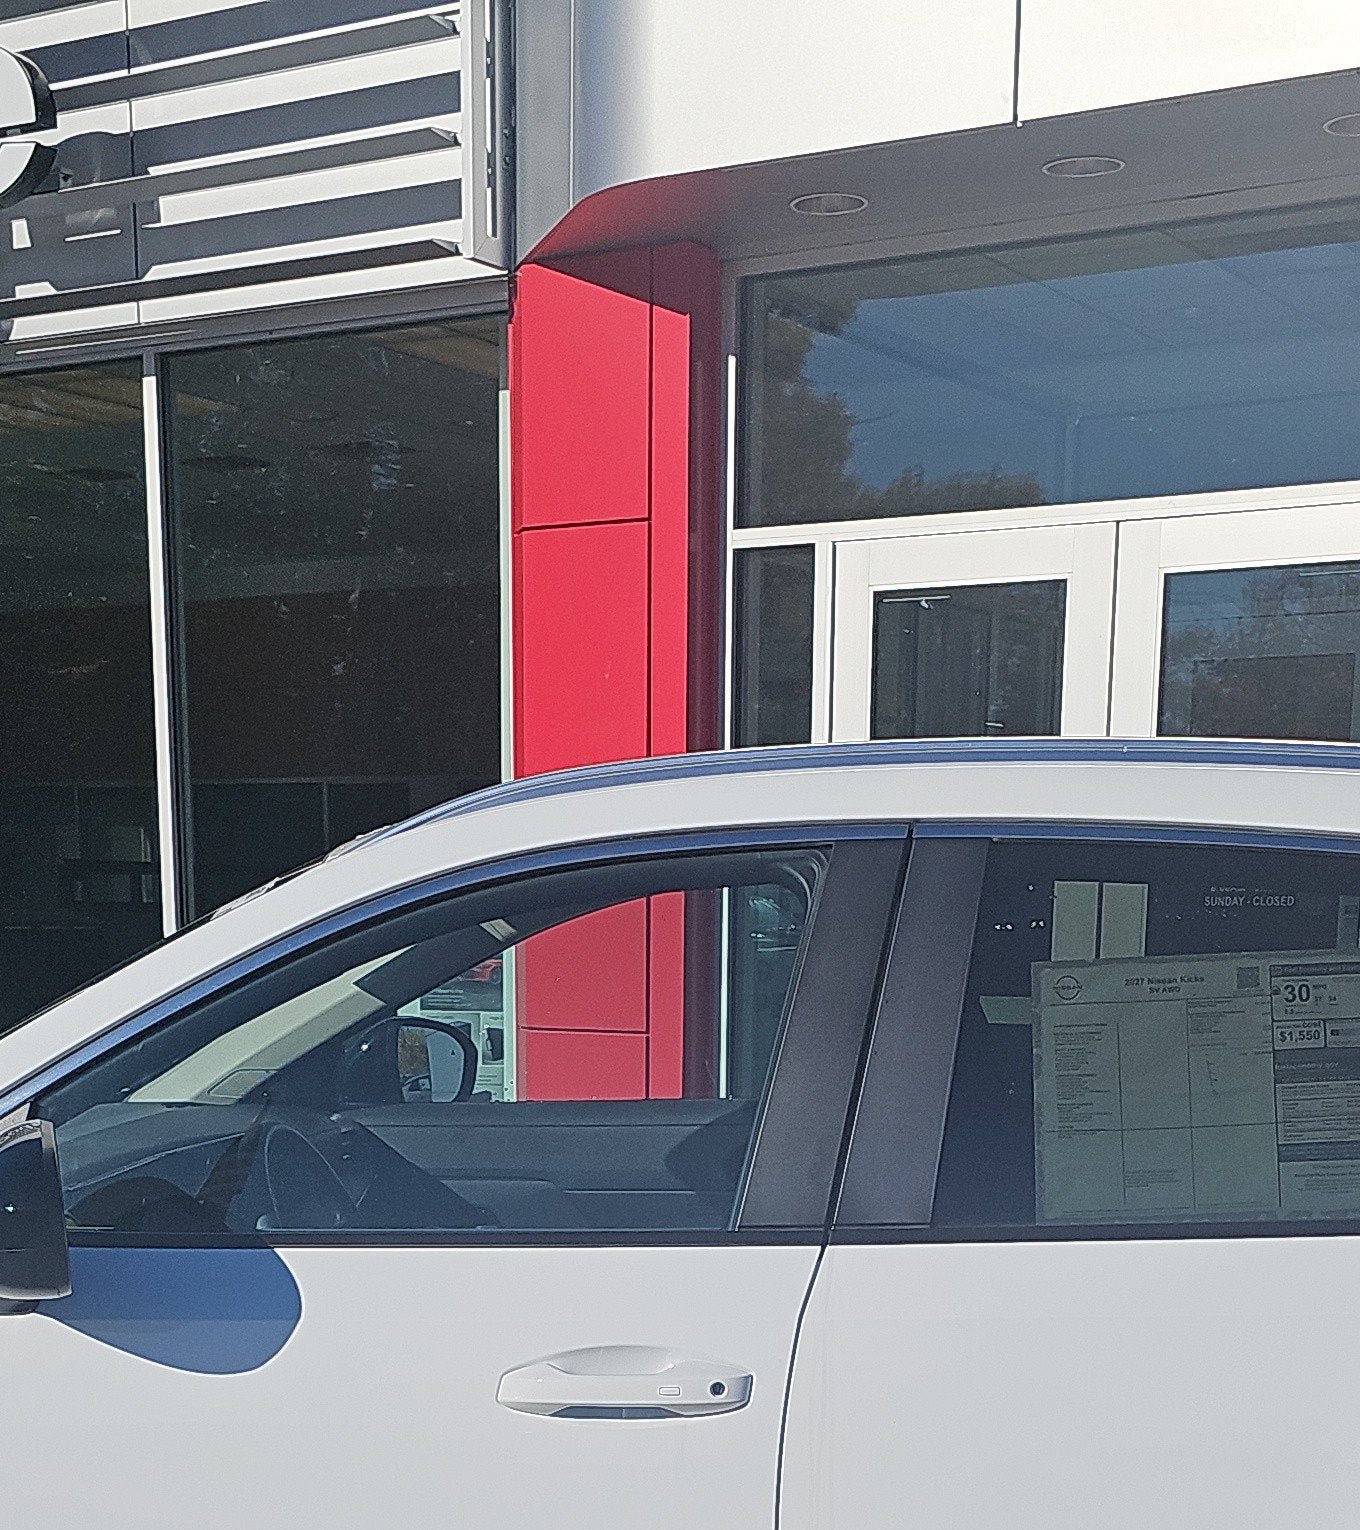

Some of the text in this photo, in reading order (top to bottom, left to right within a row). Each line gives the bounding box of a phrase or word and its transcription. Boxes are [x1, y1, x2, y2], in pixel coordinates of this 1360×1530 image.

[1204, 896, 1245, 906] SUNDAY
[1252, 896, 1295, 906] CLOSED
[1283, 983, 1311, 1003] 30
[1280, 1029, 1321, 1043] $1,550
